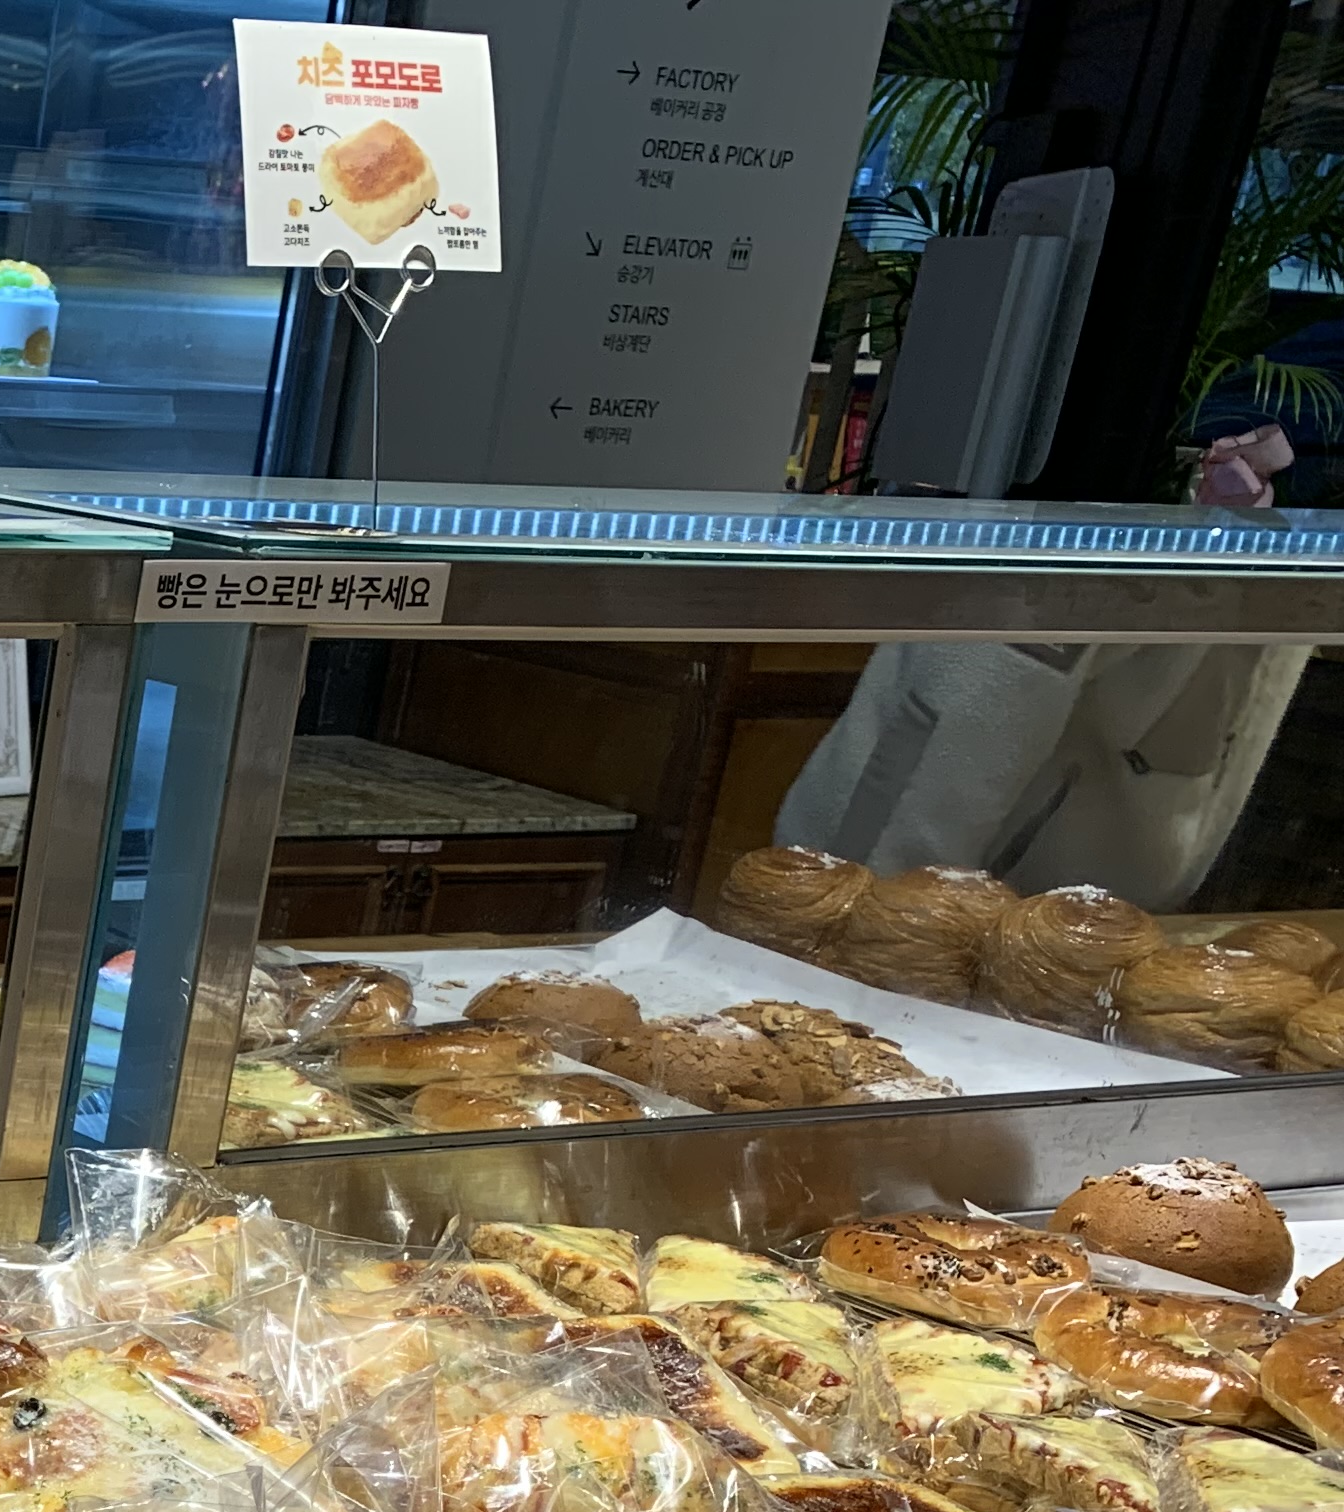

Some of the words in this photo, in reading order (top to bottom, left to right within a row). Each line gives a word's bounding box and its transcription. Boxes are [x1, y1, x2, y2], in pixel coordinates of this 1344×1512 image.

[297, 55, 345, 88] 치즈
[351, 59, 443, 93] 포모도로
[655, 66, 740, 93] FACTORY
[364, 95, 391, 108] 맛있는
[393, 97, 419, 110] 피자빵
[650, 98, 701, 120] 베이커리
[702, 101, 727, 122] 공장
[642, 138, 705, 162] ORDER
[709, 143, 721, 163] &
[724, 145, 766, 168] PICK
[769, 150, 794, 170] UP
[635, 169, 674, 190] 계산대
[622, 234, 712, 261] ELEVATOR
[617, 265, 655, 286] 승강기
[608, 304, 670, 327] STAIRS
[589, 397, 660, 419] BAKERY
[584, 426, 631, 445] 베이커리
[157, 572, 207, 610] 빵은
[215, 573, 323, 610] 눈으로만
[328, 574, 431, 612] 봐주세요
